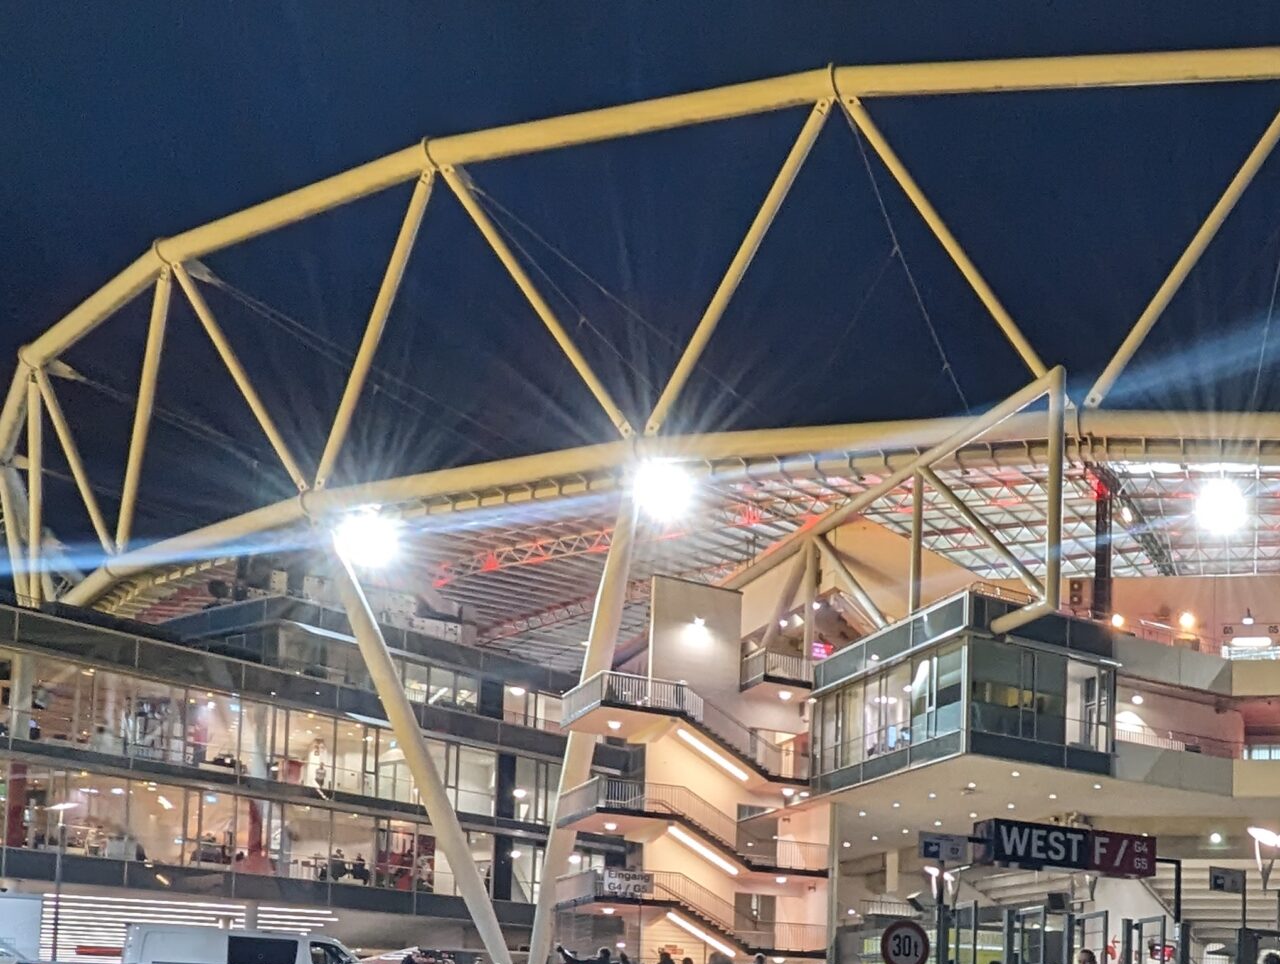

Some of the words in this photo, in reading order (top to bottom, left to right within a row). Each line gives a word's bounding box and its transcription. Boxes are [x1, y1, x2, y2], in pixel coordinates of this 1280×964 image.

[1001, 825, 1083, 862] WEST
[1094, 836, 1110, 865] F
[1134, 840, 1148, 853] G4
[1134, 857, 1148, 870] G5
[608, 870, 650, 883] Eingang
[892, 934, 912, 957] 30
[914, 941, 919, 957] t
